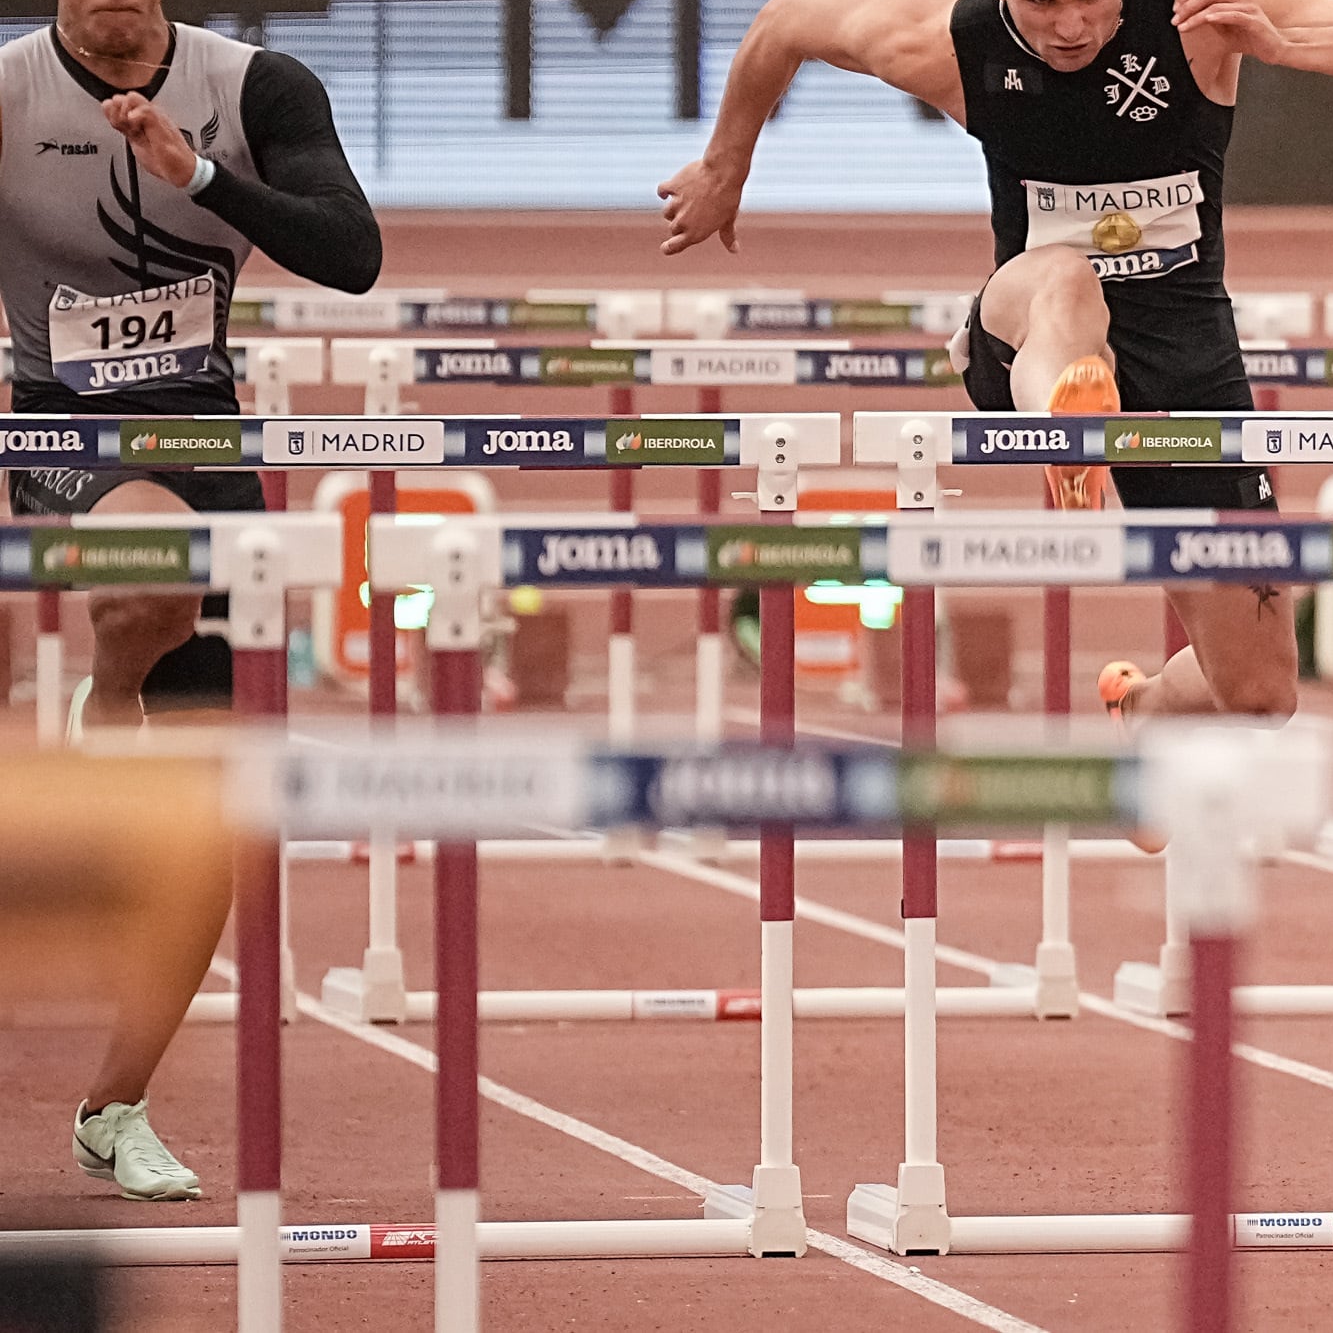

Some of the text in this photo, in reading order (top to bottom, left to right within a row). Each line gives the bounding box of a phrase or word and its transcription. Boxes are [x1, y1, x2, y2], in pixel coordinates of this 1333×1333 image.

[1076, 183, 1193, 211] MADRID
[1089, 252, 1164, 279] oma
[91, 310, 176, 350] 194
[159, 437, 233, 450] IBERDROLA
[321, 433, 425, 453] MADRID
[483, 429, 573, 455] Joma
[644, 437, 716, 449] IBERDROLA
[980, 429, 1070, 454] Joma
[1142, 436, 1213, 448] IBERDROLA
[1259, 1217, 1323, 1227] MONDO
[292, 1230, 358, 1241] MONDO
